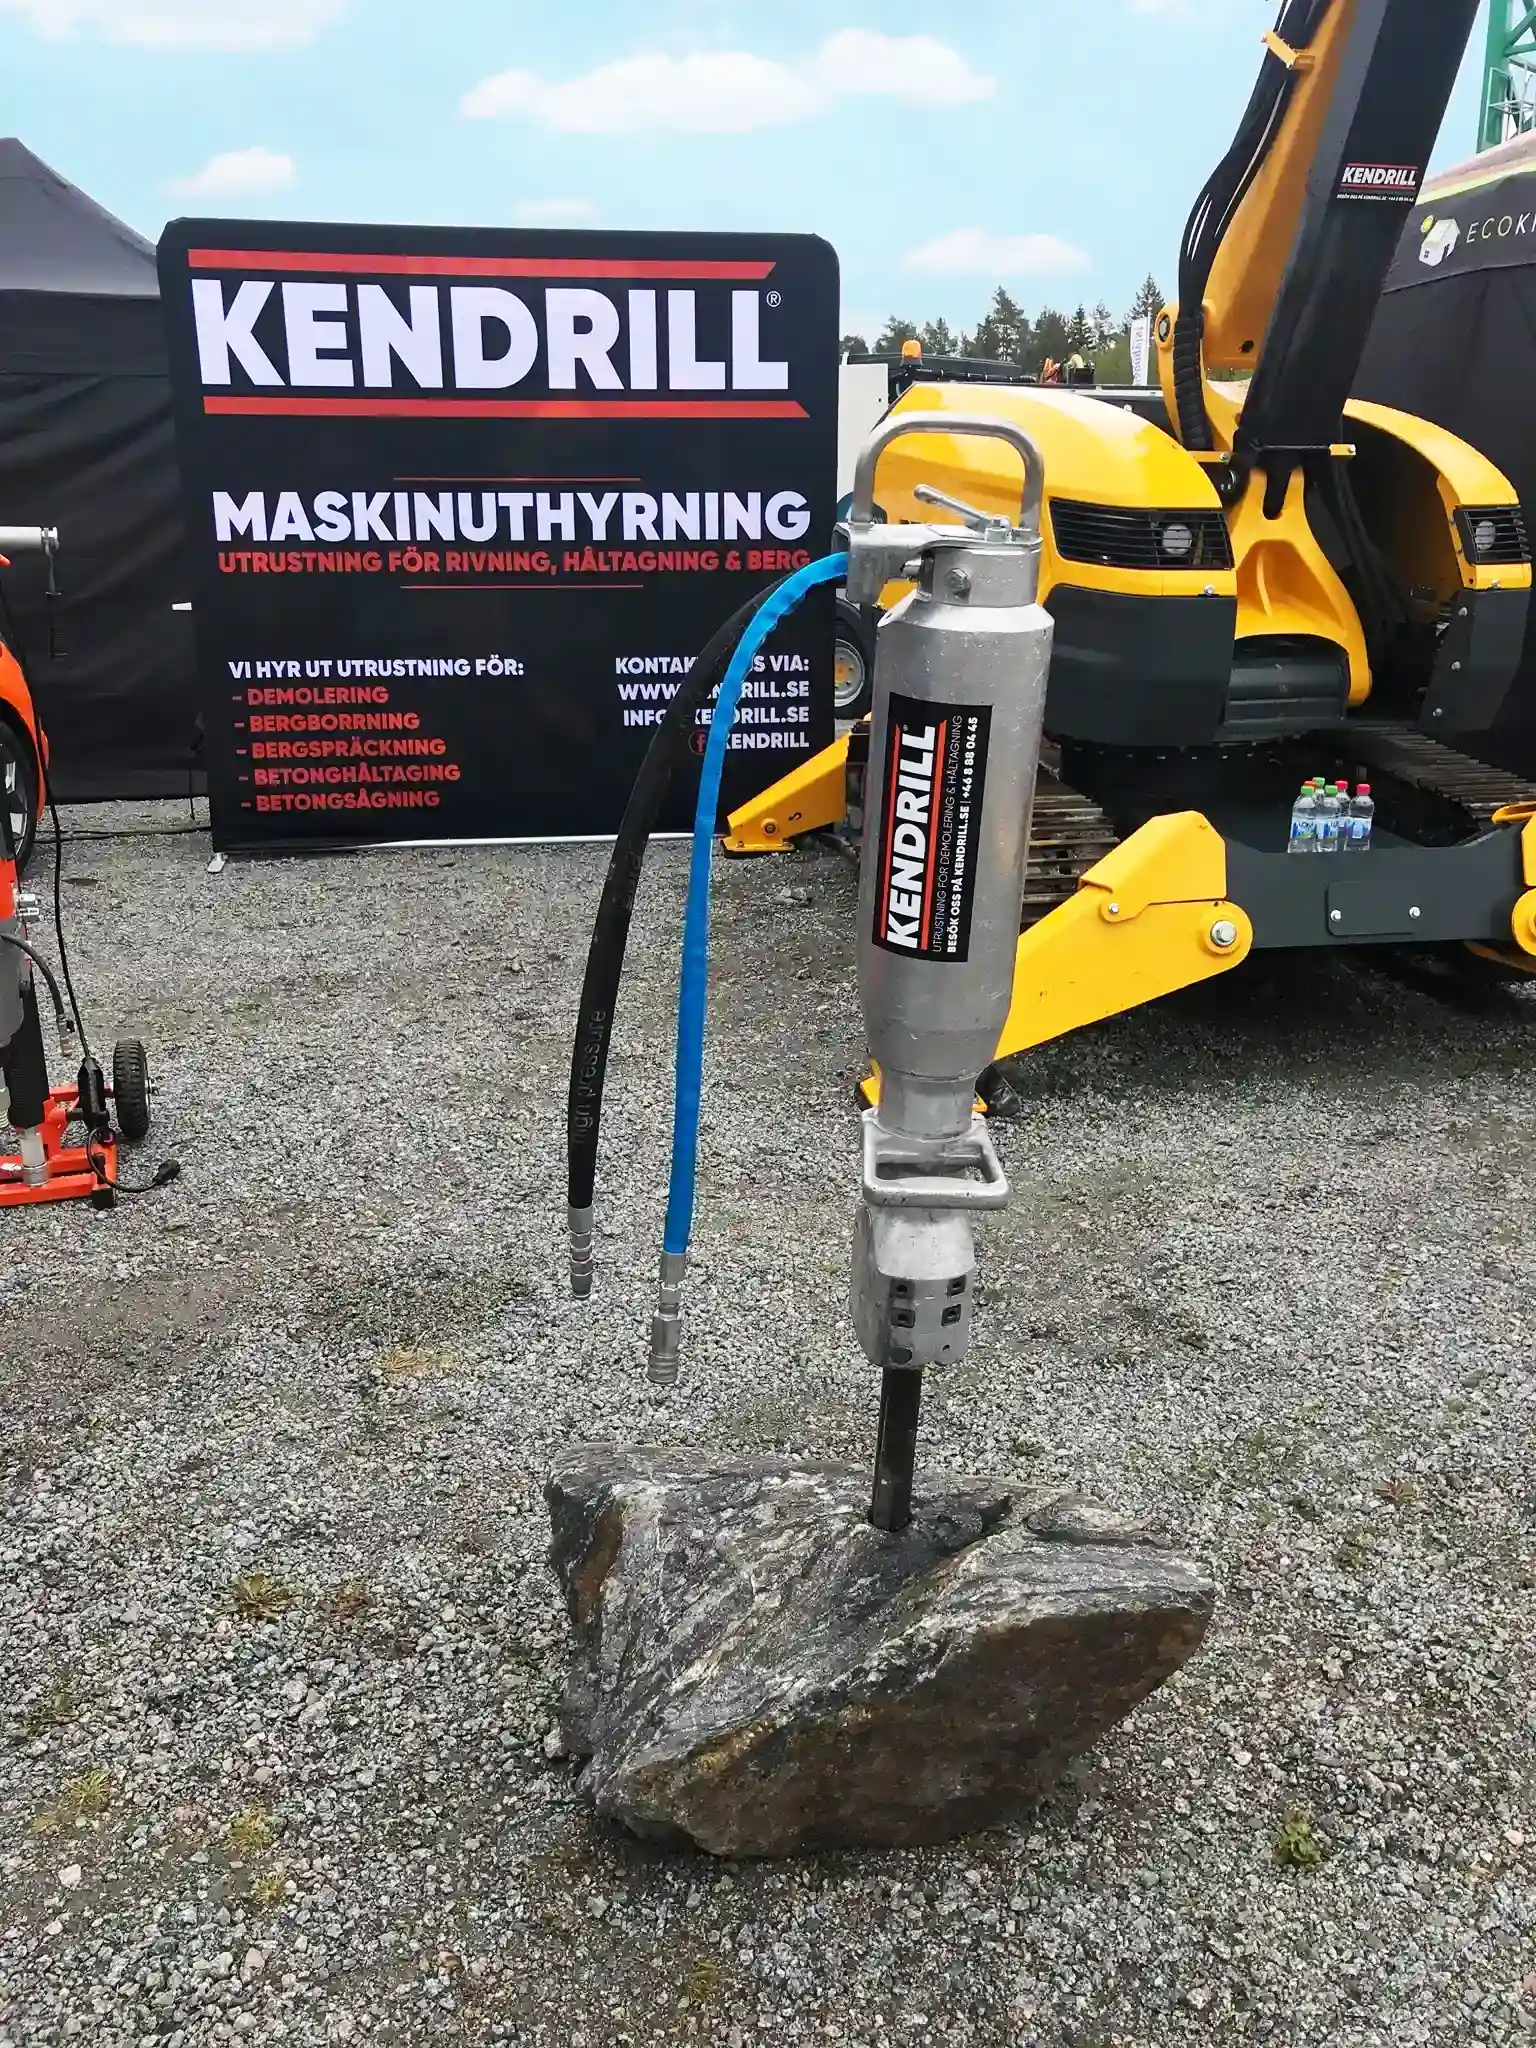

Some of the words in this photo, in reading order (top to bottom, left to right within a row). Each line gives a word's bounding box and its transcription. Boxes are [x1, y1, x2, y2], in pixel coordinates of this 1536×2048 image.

[1341, 167, 1415, 186] KENDRILL
[212, 490, 811, 542] MASKINUTHYRNING
[218, 551, 383, 573] UTRUSTNING
[388, 546, 440, 573] FÖR
[446, 550, 557, 576] RIVNING,
[563, 546, 719, 573] HÅLTAGNING
[725, 551, 741, 571] &
[747, 549, 810, 571] BERG
[228, 661, 251, 678] VI
[256, 660, 301, 678] HYR
[305, 660, 332, 677] UT
[337, 658, 471, 677] UTRUSTNING
[475, 654, 525, 676] FÖR:
[769, 655, 810, 671] VIA:
[247, 686, 389, 706] DEMOLERING
[249, 712, 420, 733] BERGBORRNING
[967, 716, 979, 732] 45
[252, 736, 446, 759] BERGSPRÄCKNING
[966, 733, 977, 749] 04
[964, 751, 975, 766] 88
[254, 762, 461, 785] BETONGHÅLTAGING
[963, 767, 974, 776] 8
[962, 777, 973, 799] +46
[256, 788, 440, 812] BETONGSÅGNING
[954, 806, 970, 876] KENDRILL.SE
[933, 890, 947, 953] UTRUSTNING
[940, 796, 955, 865] DEMOLERING
[951, 877, 963, 892] PÅ
[951, 893, 962, 916] OSS
[947, 917, 960, 953] BESÖK
[577, 1010, 606, 1098] pressure
